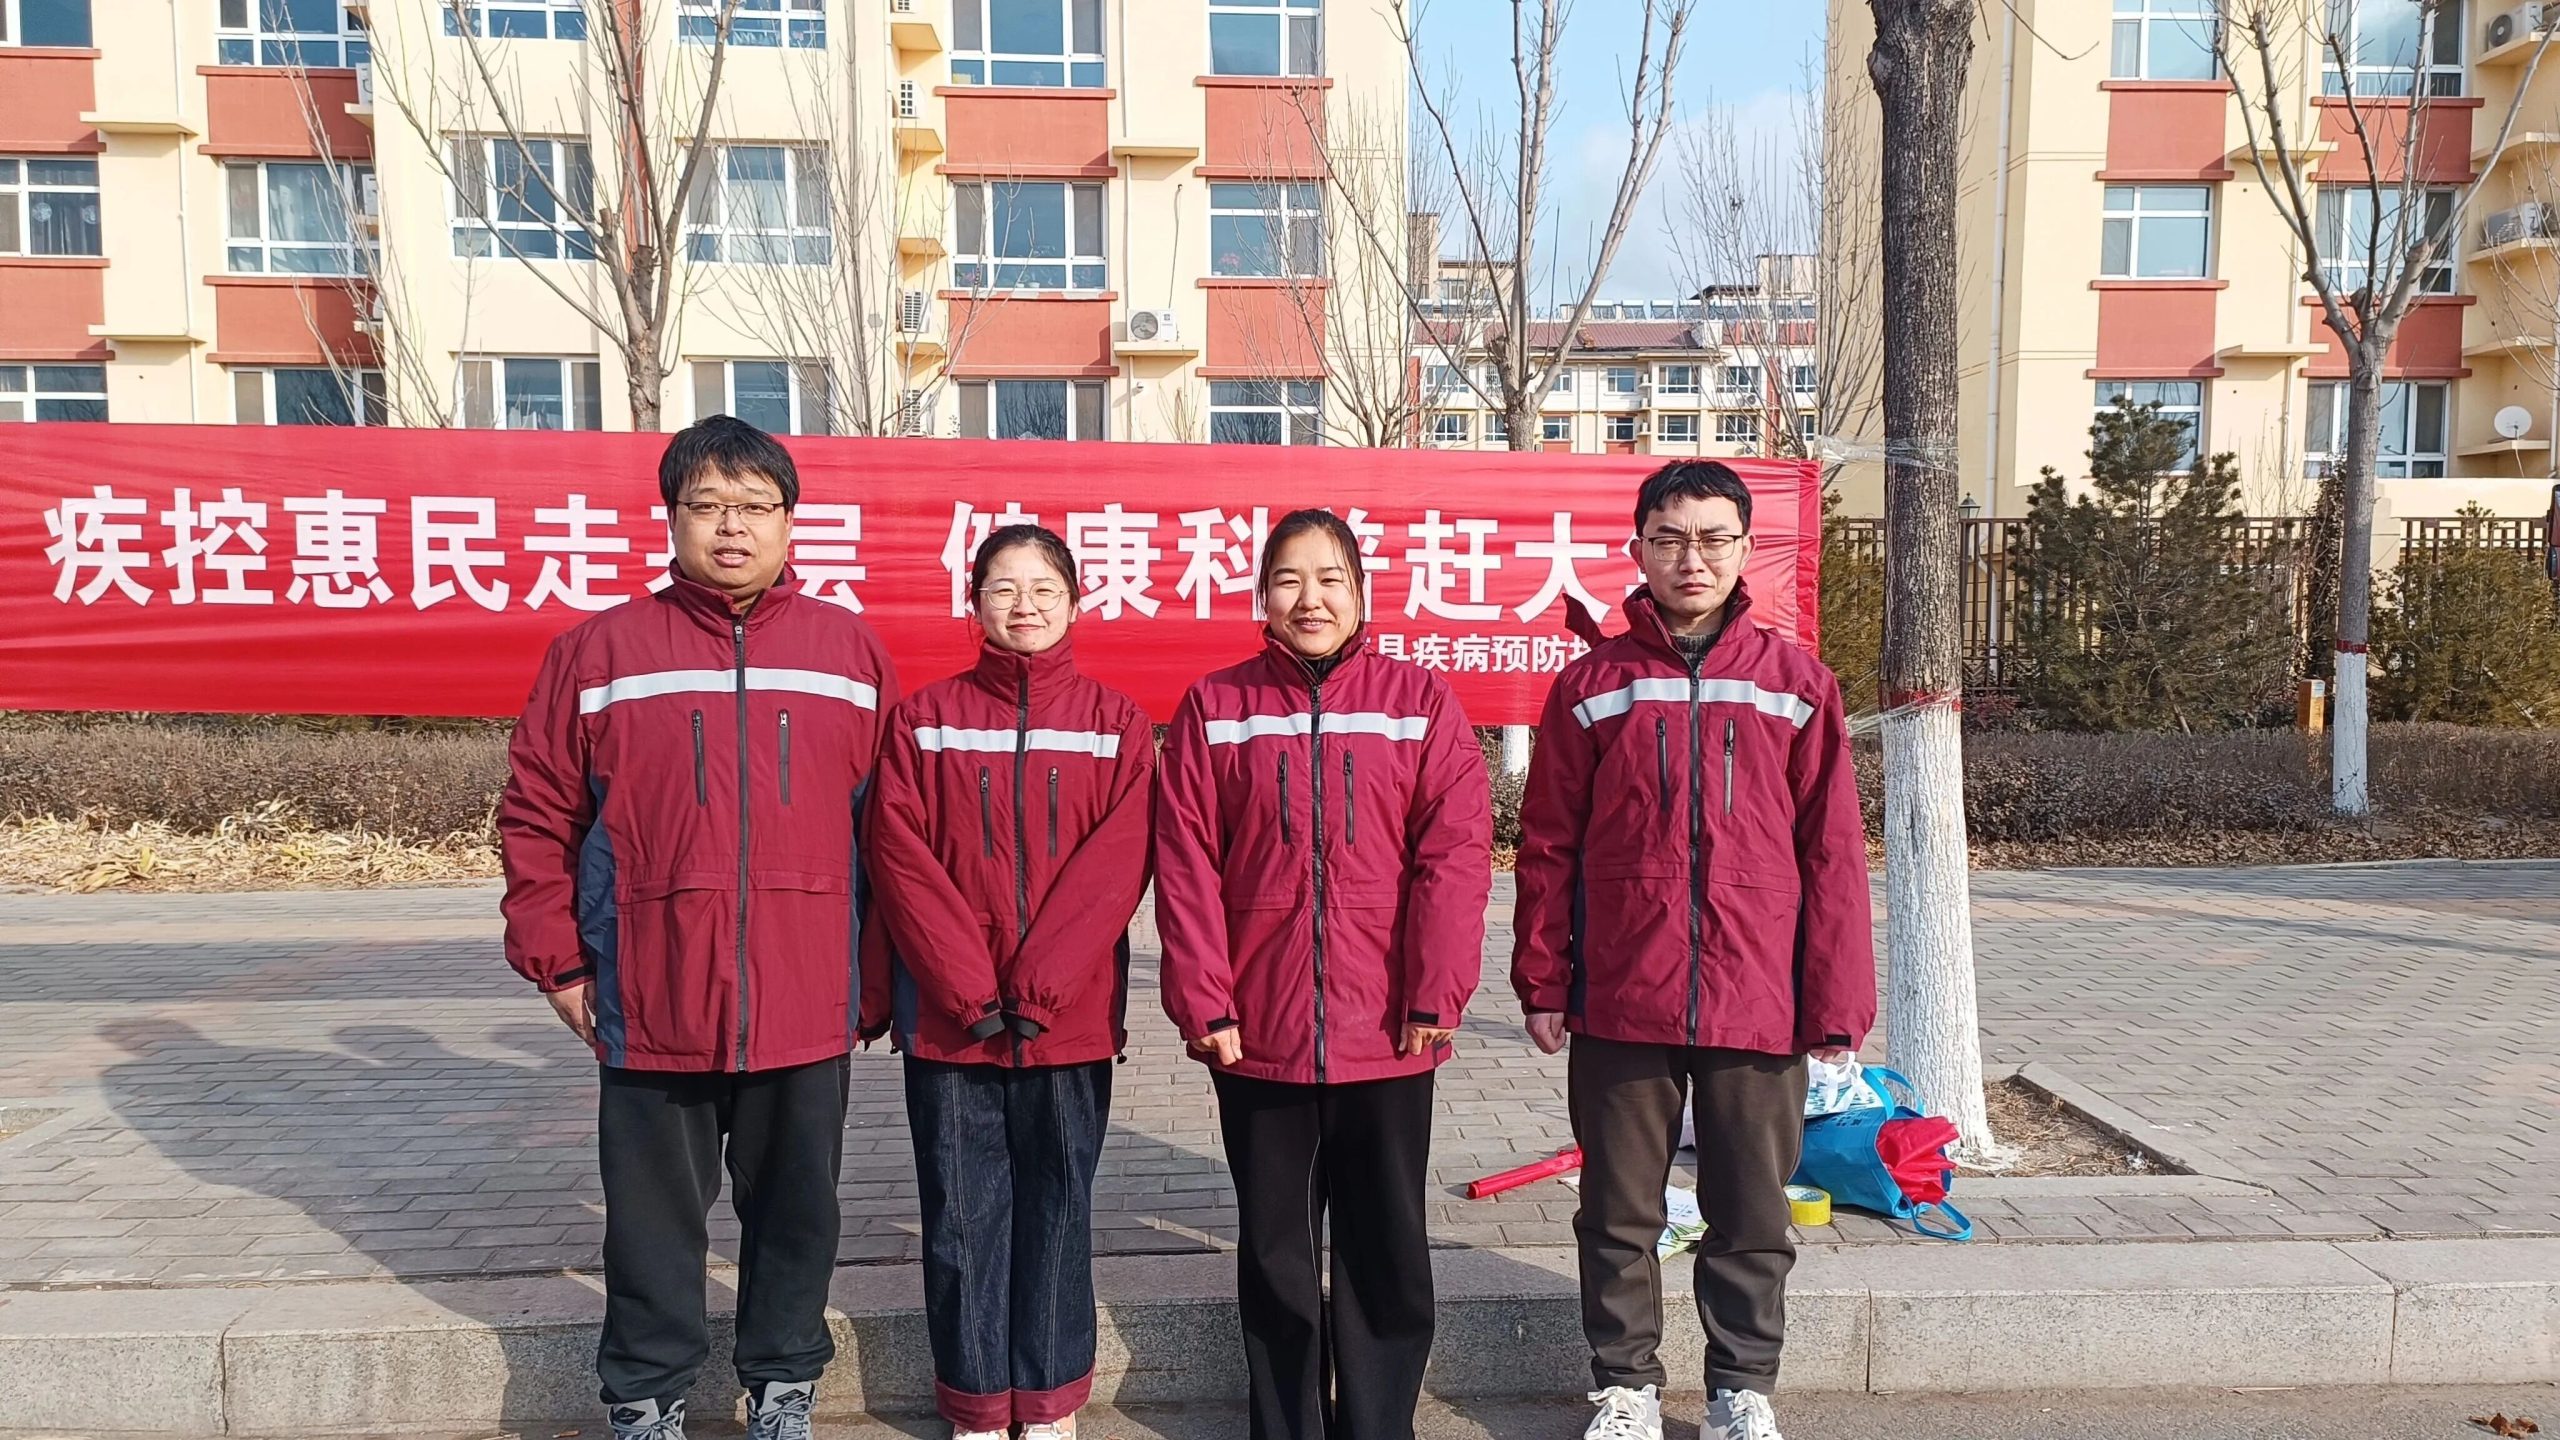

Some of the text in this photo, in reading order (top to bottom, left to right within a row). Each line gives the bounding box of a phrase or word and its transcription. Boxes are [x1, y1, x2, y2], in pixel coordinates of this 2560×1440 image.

[1364, 633, 1593, 673] 县疾病预防
